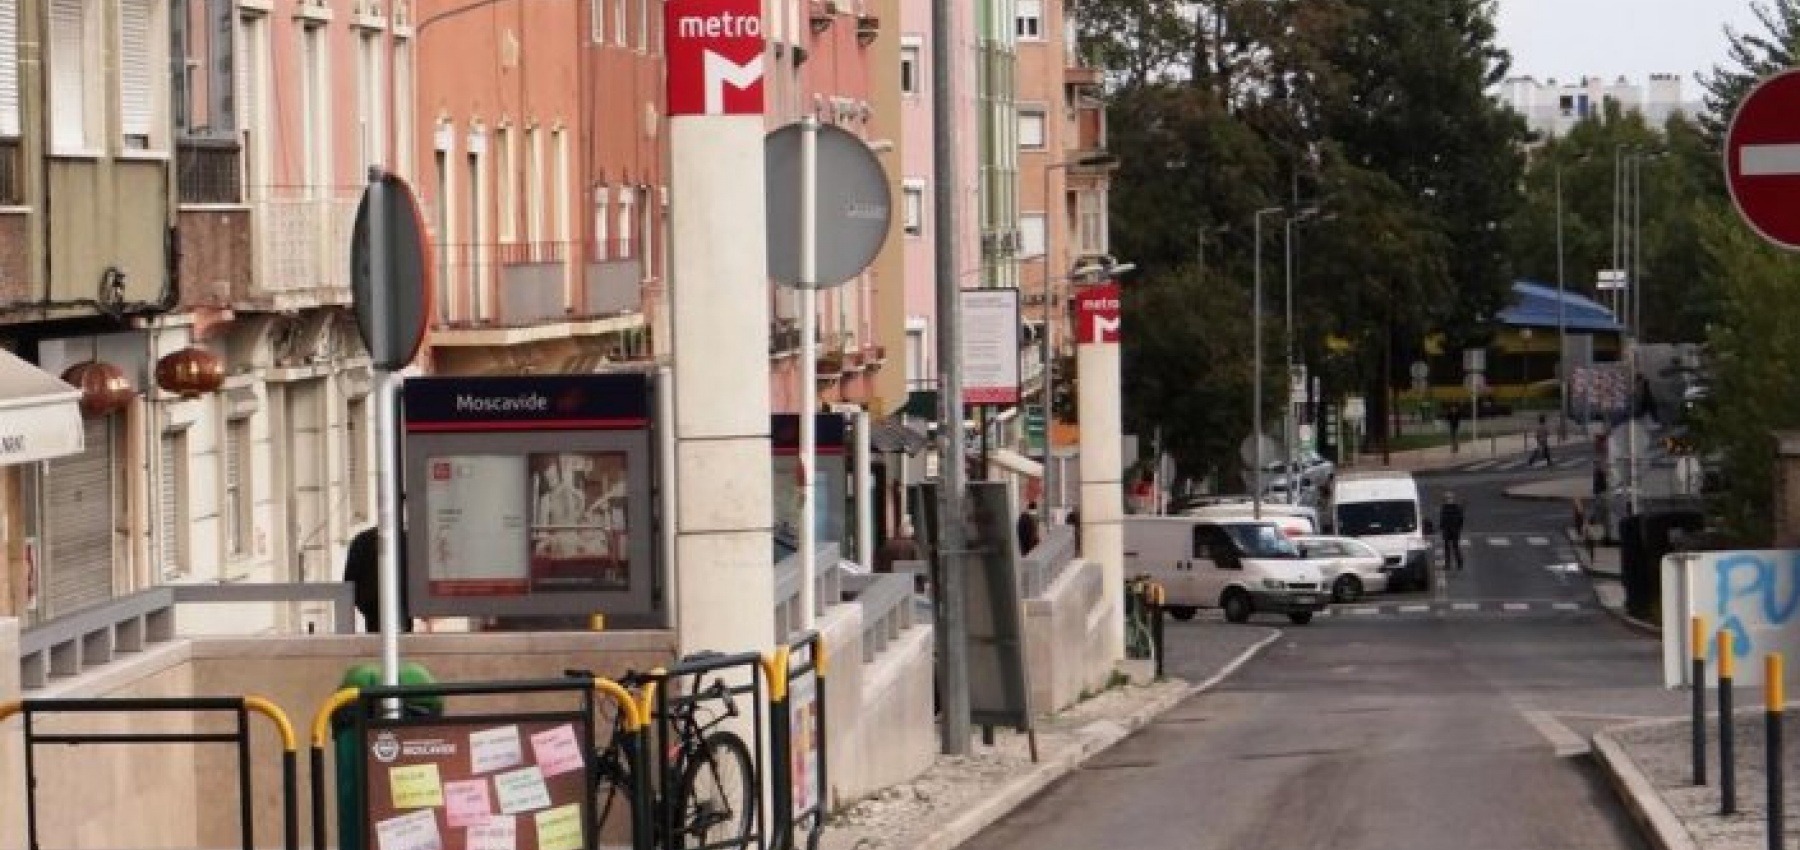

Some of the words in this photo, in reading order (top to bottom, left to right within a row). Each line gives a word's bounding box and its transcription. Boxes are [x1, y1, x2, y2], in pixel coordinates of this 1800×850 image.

[679, 11, 760, 37] metro
[1082, 297, 1120, 310] metro
[456, 393, 547, 411] Moscavide
